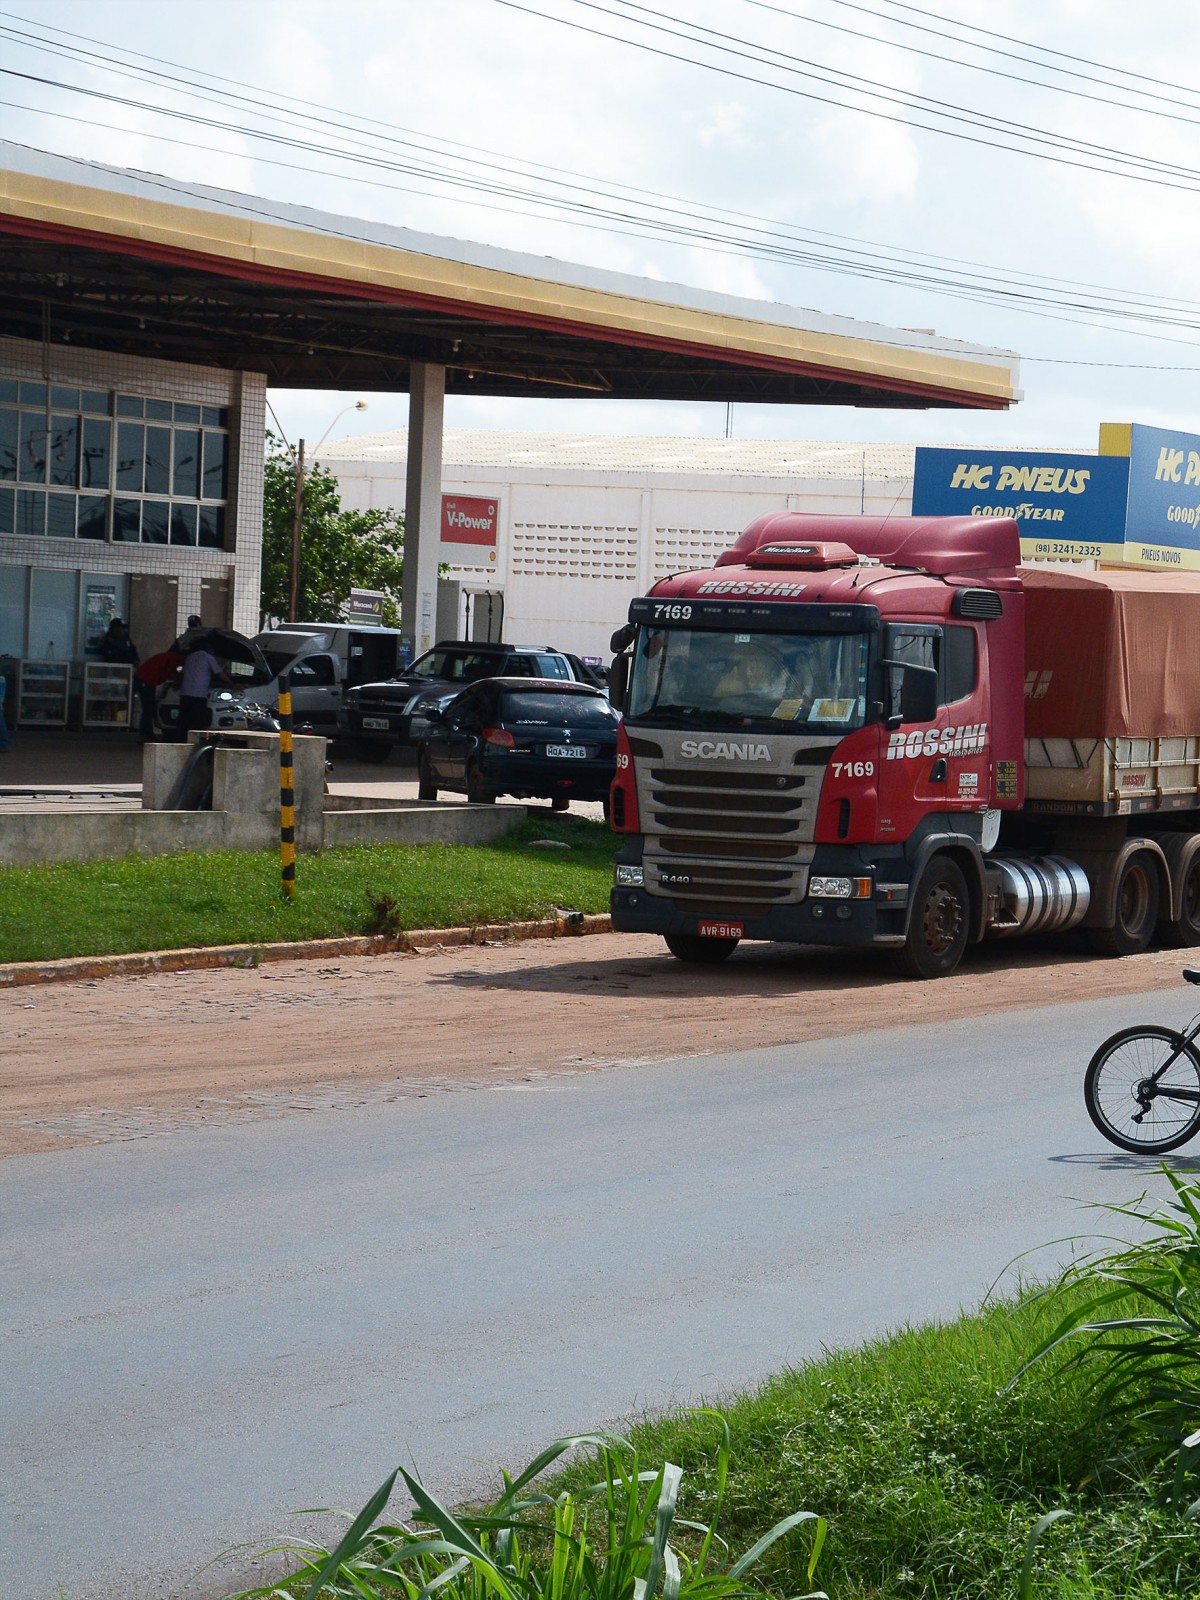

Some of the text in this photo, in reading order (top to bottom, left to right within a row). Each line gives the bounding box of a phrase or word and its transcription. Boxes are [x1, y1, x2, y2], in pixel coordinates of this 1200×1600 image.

[1155, 447, 1184, 483] HC
[950, 464, 1091, 495] HC PNEUS
[446, 511, 493, 530] V-Power
[1035, 543, 1101, 556] (98) 3241-2325
[1141, 548, 1181, 564] PNEUS NOVOS
[697, 581, 808, 597] ROSSINI
[654, 604, 692, 620] 7169
[887, 723, 987, 760] ROSSINI
[681, 740, 772, 762] SCANIA
[831, 762, 874, 778] 7169
[1121, 773, 1147, 787] ROSSINI
[1032, 802, 1074, 812] RANDON
[701, 926, 742, 937] AVR-9169
